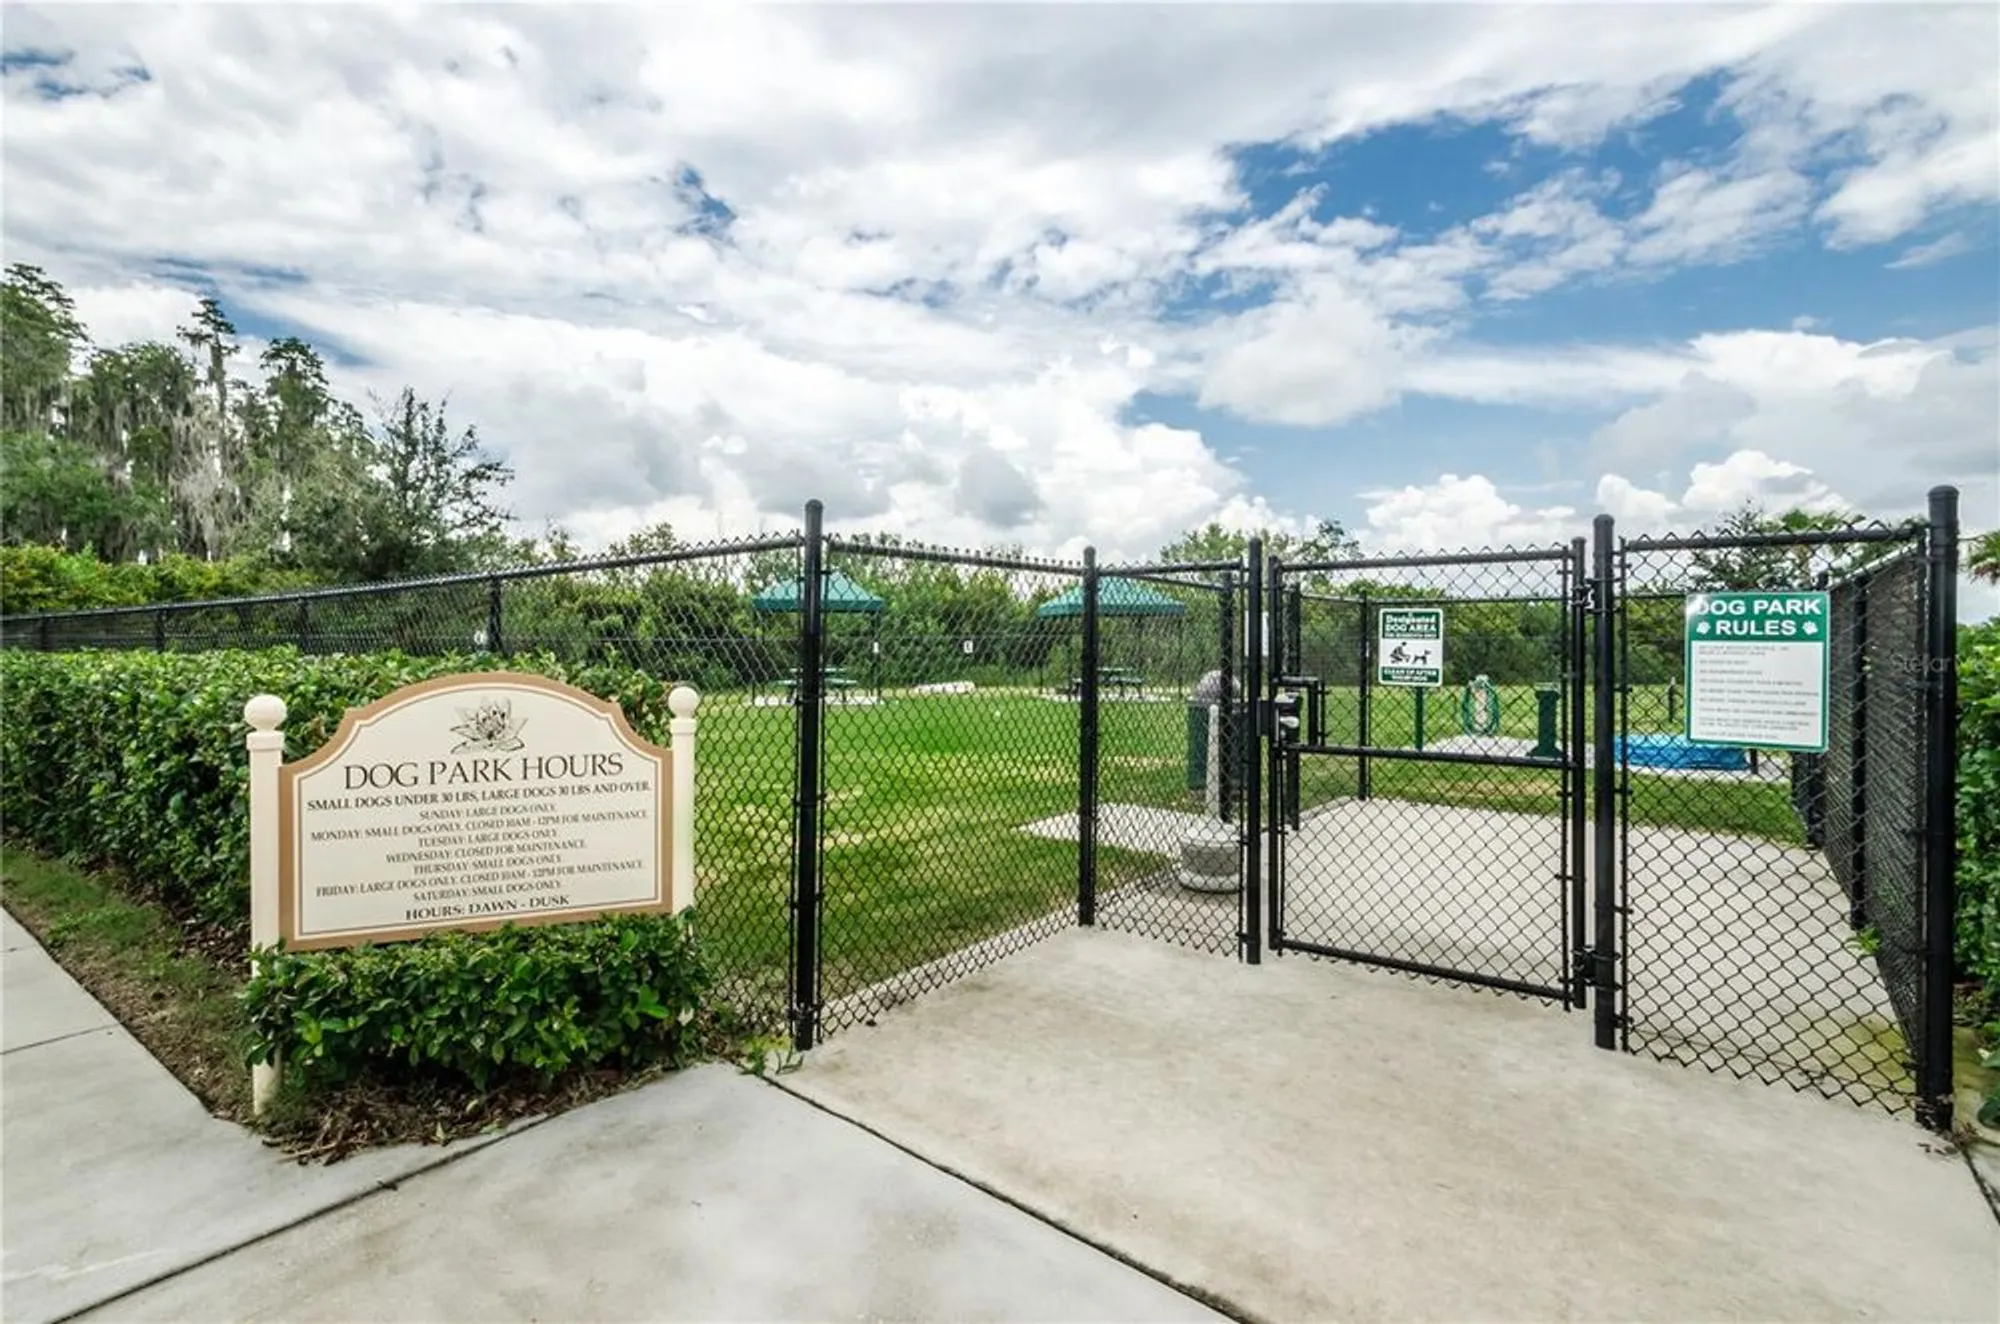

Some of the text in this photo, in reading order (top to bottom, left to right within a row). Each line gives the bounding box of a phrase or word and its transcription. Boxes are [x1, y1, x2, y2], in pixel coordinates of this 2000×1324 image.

[1753, 599, 1821, 615] PARK
[1715, 620, 1796, 635] RULES
[344, 752, 624, 790] DOG PARK HOURS
[307, 797, 352, 811] SMALL
[355, 795, 393, 809] DOGS
[395, 793, 439, 807] UNDER
[481, 788, 521, 801] LARGE
[523, 785, 556, 799] DOGS
[571, 784, 592, 796] LBS
[592, 782, 618, 795] AND
[466, 806, 498, 818] LARGE
[500, 804, 528, 815] DOGS
[364, 826, 399, 838] SMALL
[402, 824, 433, 836] DOGS
[465, 820, 505, 831] CLOSED
[562, 813, 580, 824] FOR
[468, 833, 500, 845] LARGE
[502, 831, 530, 841] DOGS
[454, 846, 495, 858] CLOSED
[496, 844, 515, 856] FOR
[472, 859, 504, 870] SMALL
[506, 856, 535, 867] DOGS
[360, 880, 394, 893] LARGE
[396, 878, 427, 890] DOGS
[460, 872, 500, 884] CLOSED
[557, 865, 575, 876] FOR
[472, 885, 504, 896] SMALL
[506, 882, 534, 893] DOGS
[405, 904, 465, 920] HOURS:
[468, 899, 518, 914] DAWN
[529, 894, 570, 908] DUSK
